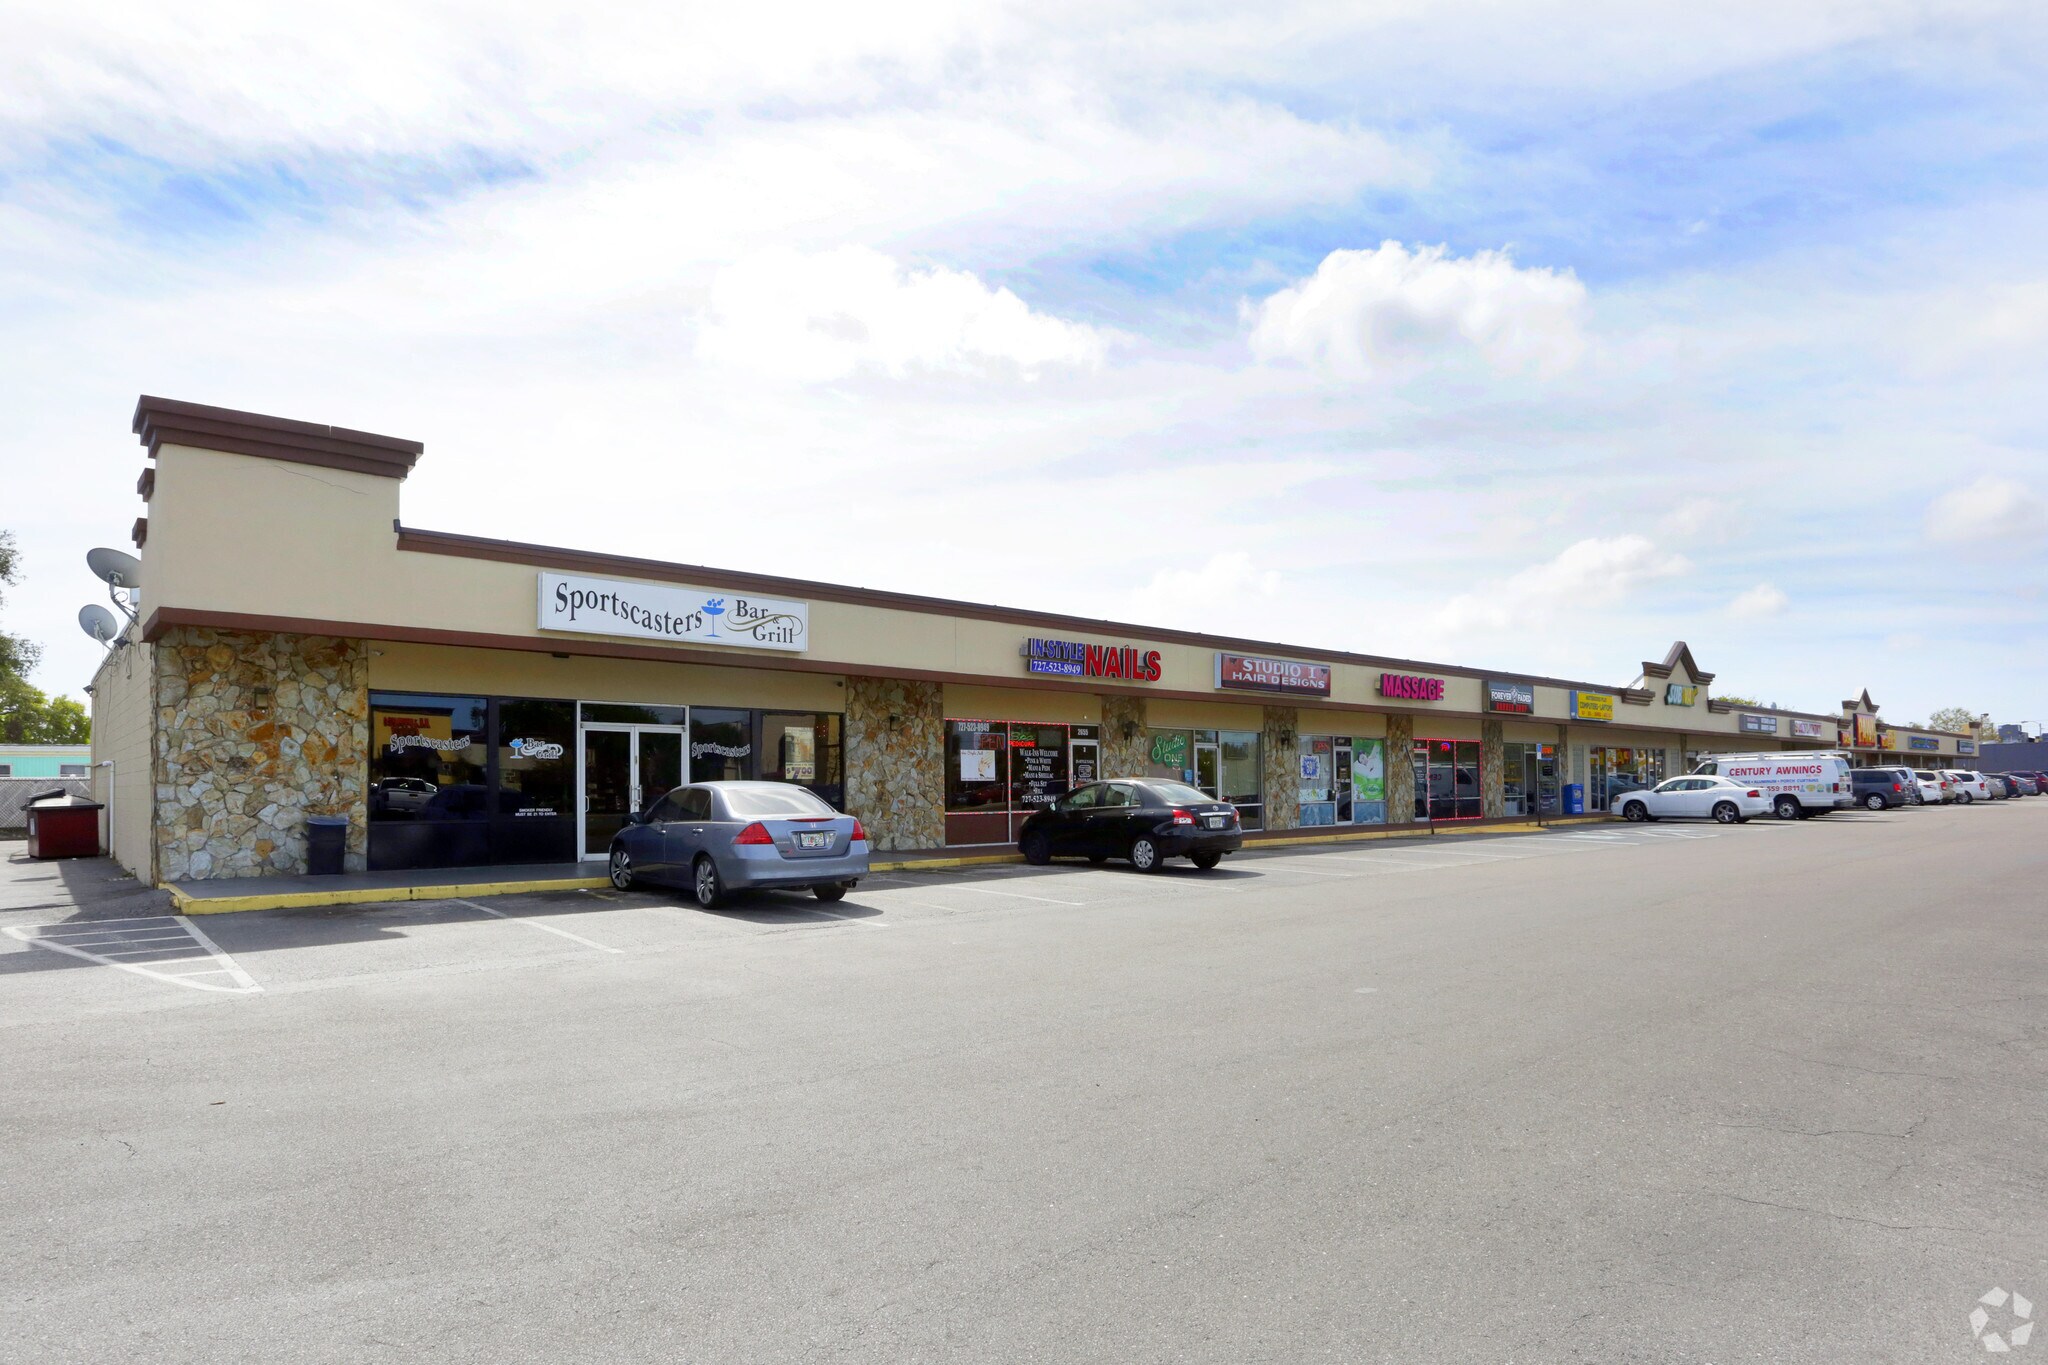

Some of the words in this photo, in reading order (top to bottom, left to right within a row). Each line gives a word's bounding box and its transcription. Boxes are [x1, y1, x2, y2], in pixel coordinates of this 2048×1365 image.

[555, 582, 703, 636] Sportscasters
[736, 600, 768, 619] Bar
[752, 625, 794, 644] Grill
[1028, 637, 1084, 660] IN-STYLE
[1033, 661, 1081, 674] 727-523-8949
[1084, 643, 1162, 682] NAILS
[1243, 659, 1302, 677] STUDIO
[1232, 671, 1267, 683] HAIR
[1271, 676, 1325, 689] DESIGNS
[1381, 673, 1445, 700] MASSAGE
[1491, 691, 1511, 701] FOREVER
[1517, 693, 1532, 703] FADED
[1667, 685, 1699, 705] SUBWAY
[390, 734, 470, 754] Sportscasters
[526, 738, 545, 748] Bar
[692, 742, 751, 760] Sportscasters
[1152, 735, 1185, 760] Studio
[1164, 753, 1183, 763] ONE
[1729, 767, 1772, 777] CENTURY
[1776, 765, 1822, 775] AWNINGS
